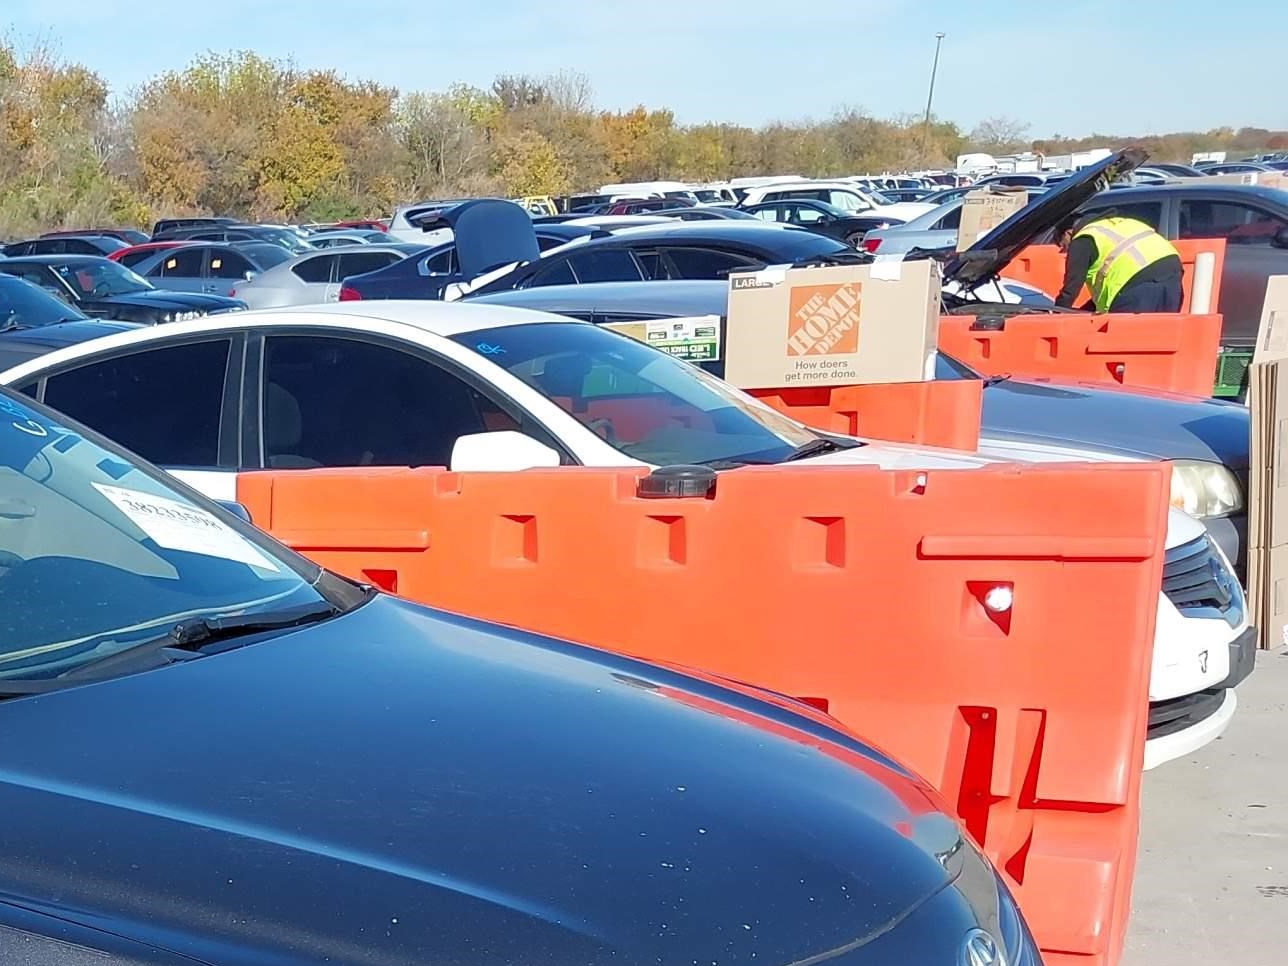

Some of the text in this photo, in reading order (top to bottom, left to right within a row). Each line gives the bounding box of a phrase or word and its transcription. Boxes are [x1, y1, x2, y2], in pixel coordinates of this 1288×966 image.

[787, 283, 861, 356] HOME
[795, 292, 827, 320] THE
[815, 308, 861, 354] DEPOT
[785, 372, 801, 382] get
[795, 360, 848, 369] How doers
